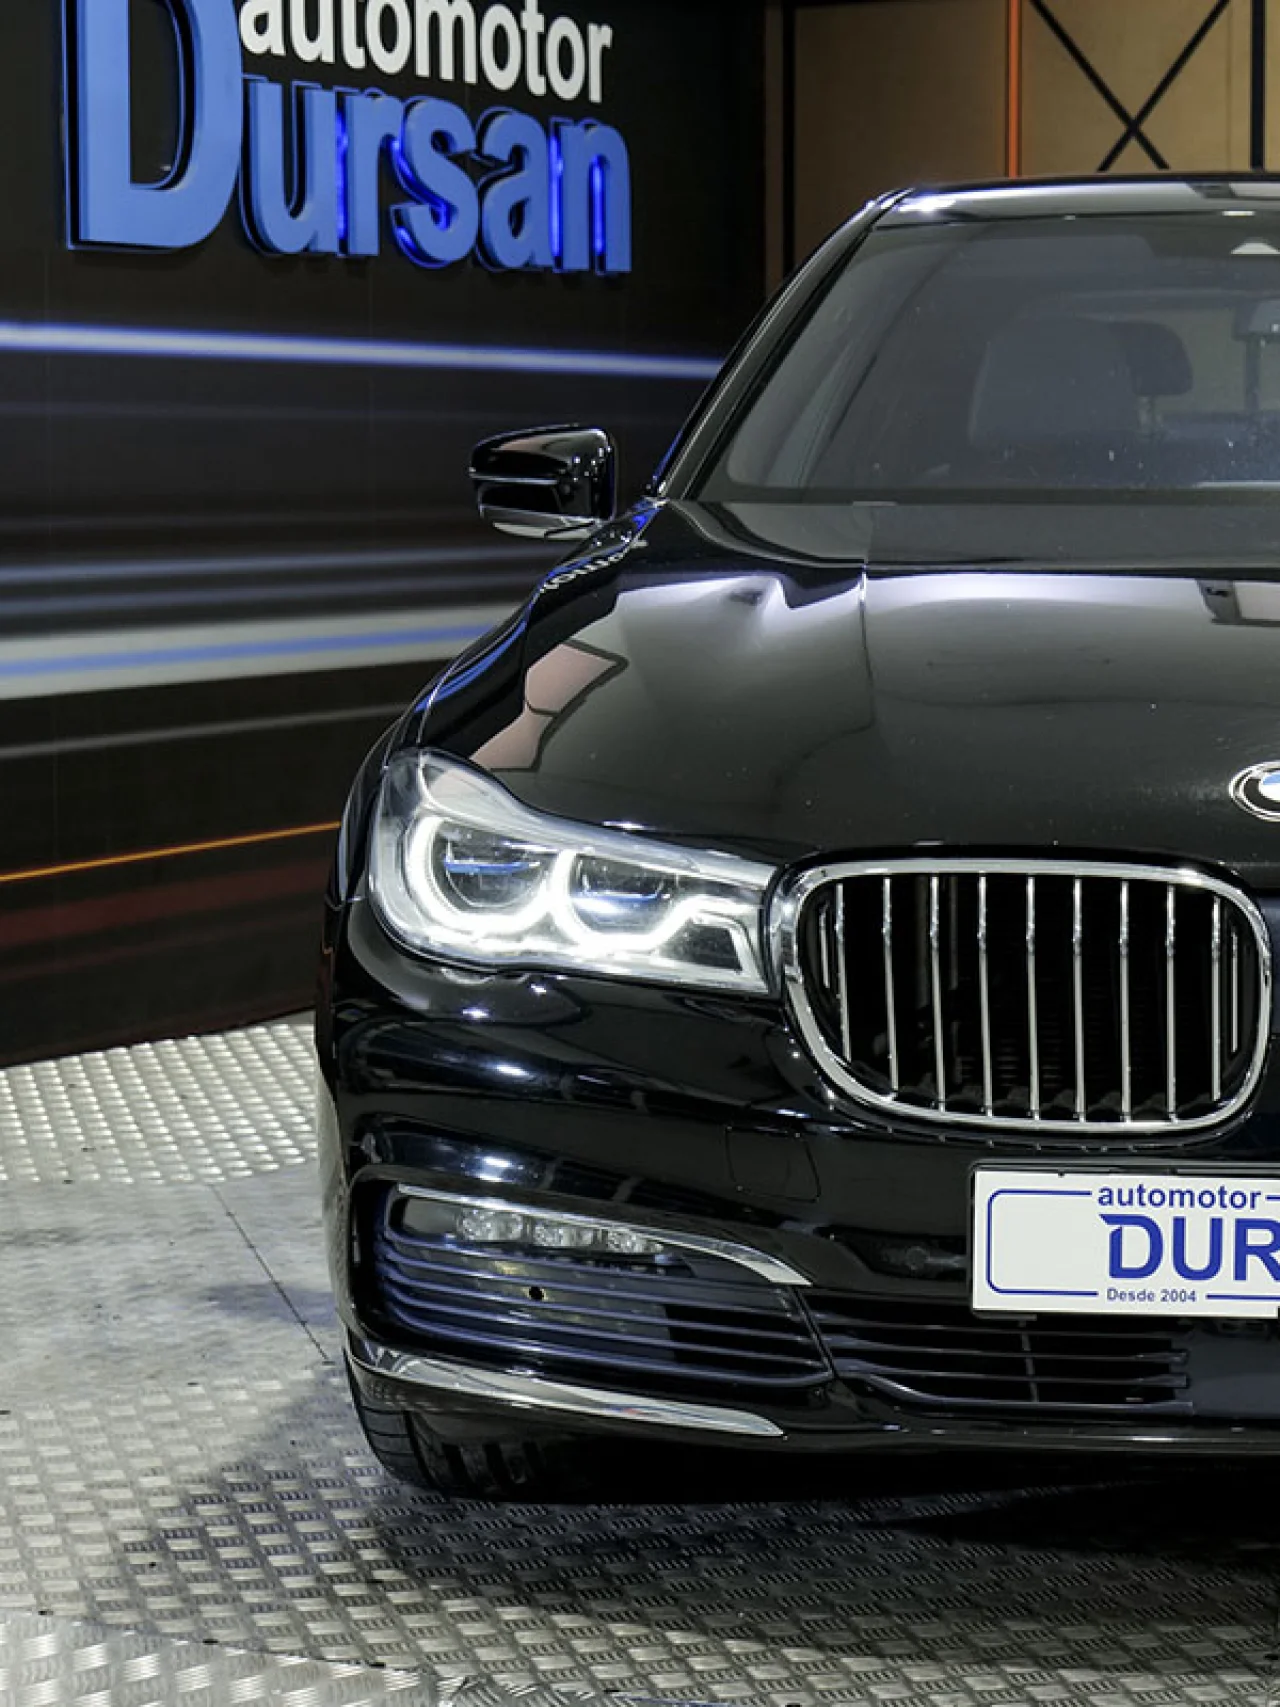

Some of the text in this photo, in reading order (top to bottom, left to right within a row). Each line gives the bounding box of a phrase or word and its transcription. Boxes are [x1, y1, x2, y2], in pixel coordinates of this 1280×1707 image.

[240, 0, 613, 103] automotor
[65, 0, 632, 273] Dursan
[1097, 1184, 1262, 1210] automotor
[1106, 1287, 1198, 1303] Desde 2004
